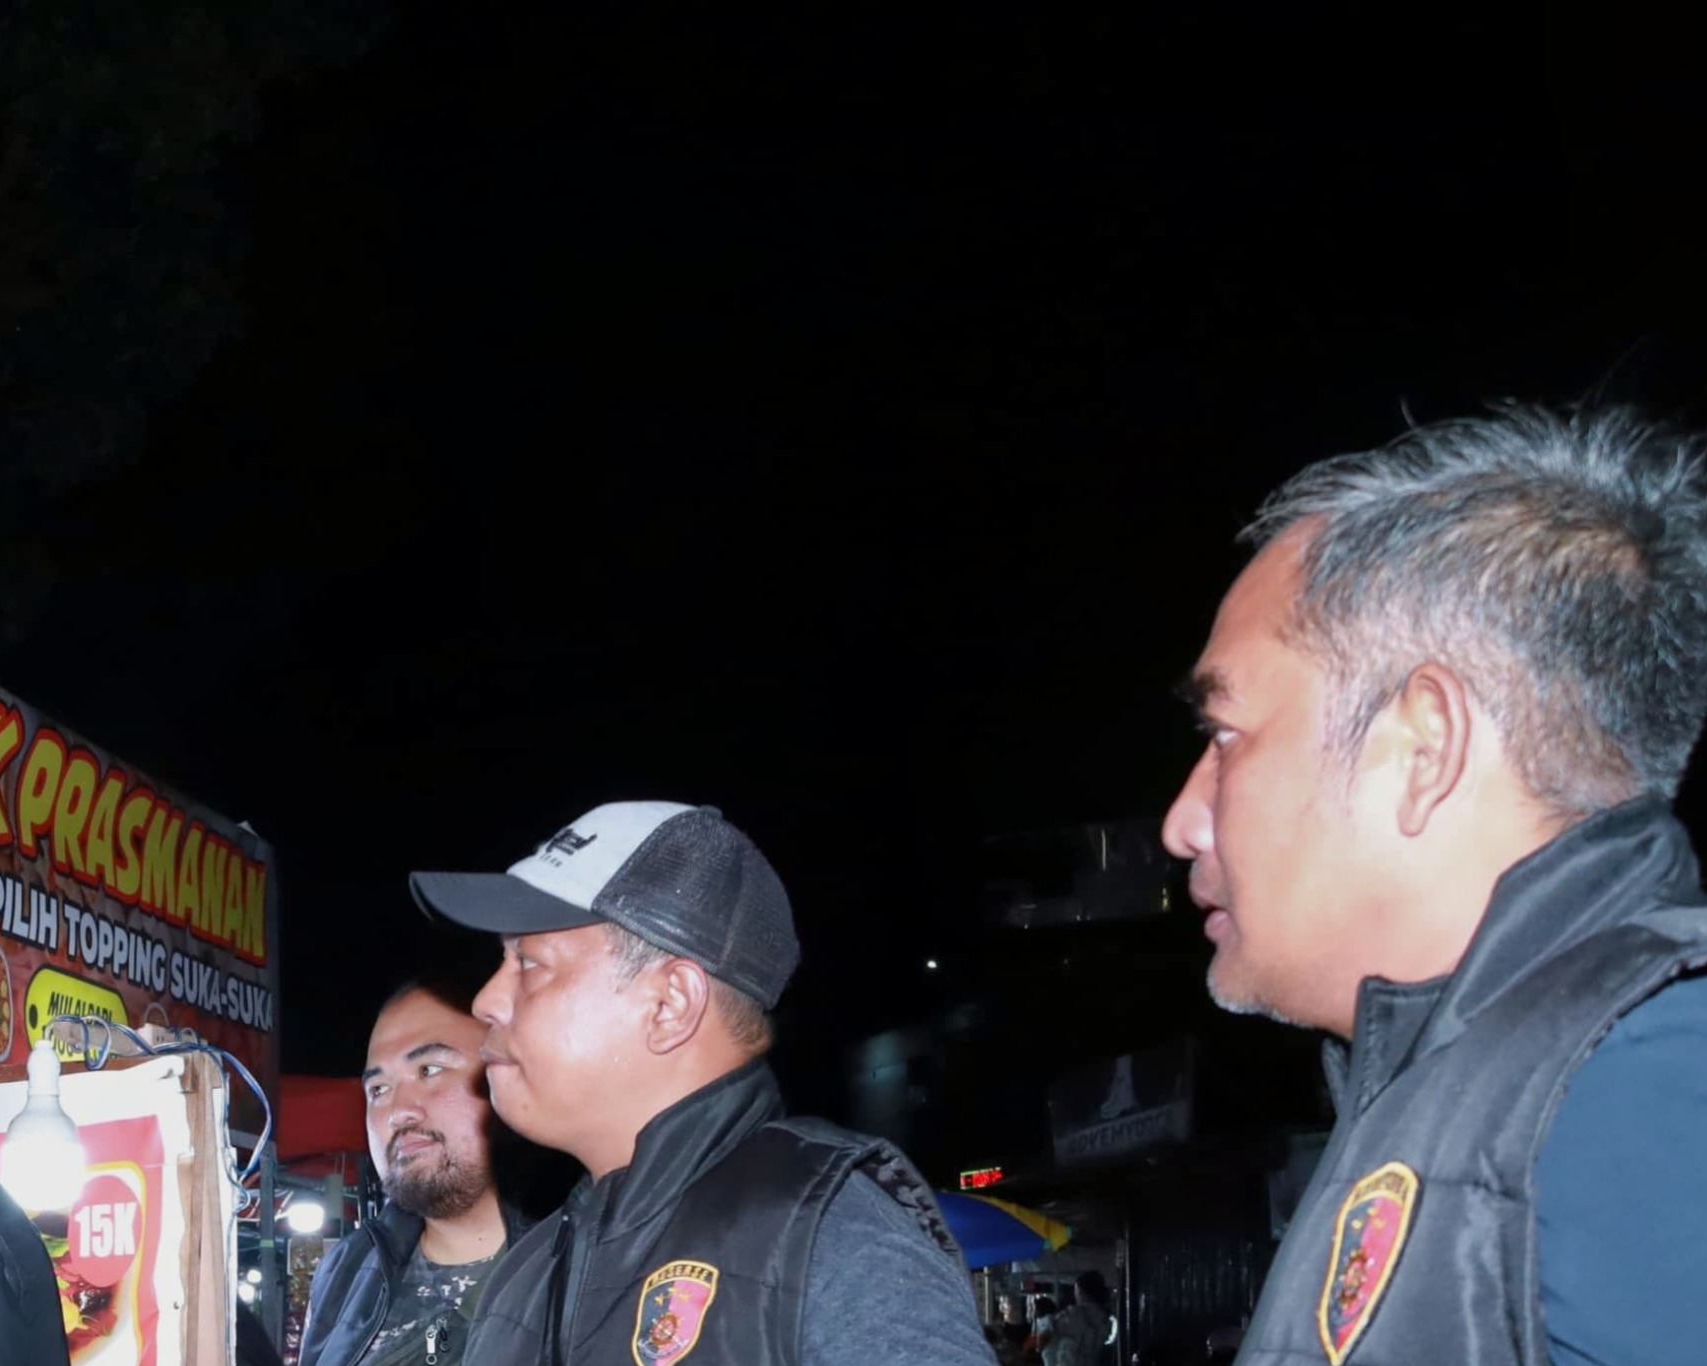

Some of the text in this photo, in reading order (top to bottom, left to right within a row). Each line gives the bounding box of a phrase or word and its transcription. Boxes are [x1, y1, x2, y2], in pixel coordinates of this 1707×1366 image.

[17, 732, 268, 962] PRASMANAN
[64, 904, 166, 992] TOPPING
[170, 951, 274, 1031] SUKA-SUKA
[75, 1202, 137, 1257] 15K
